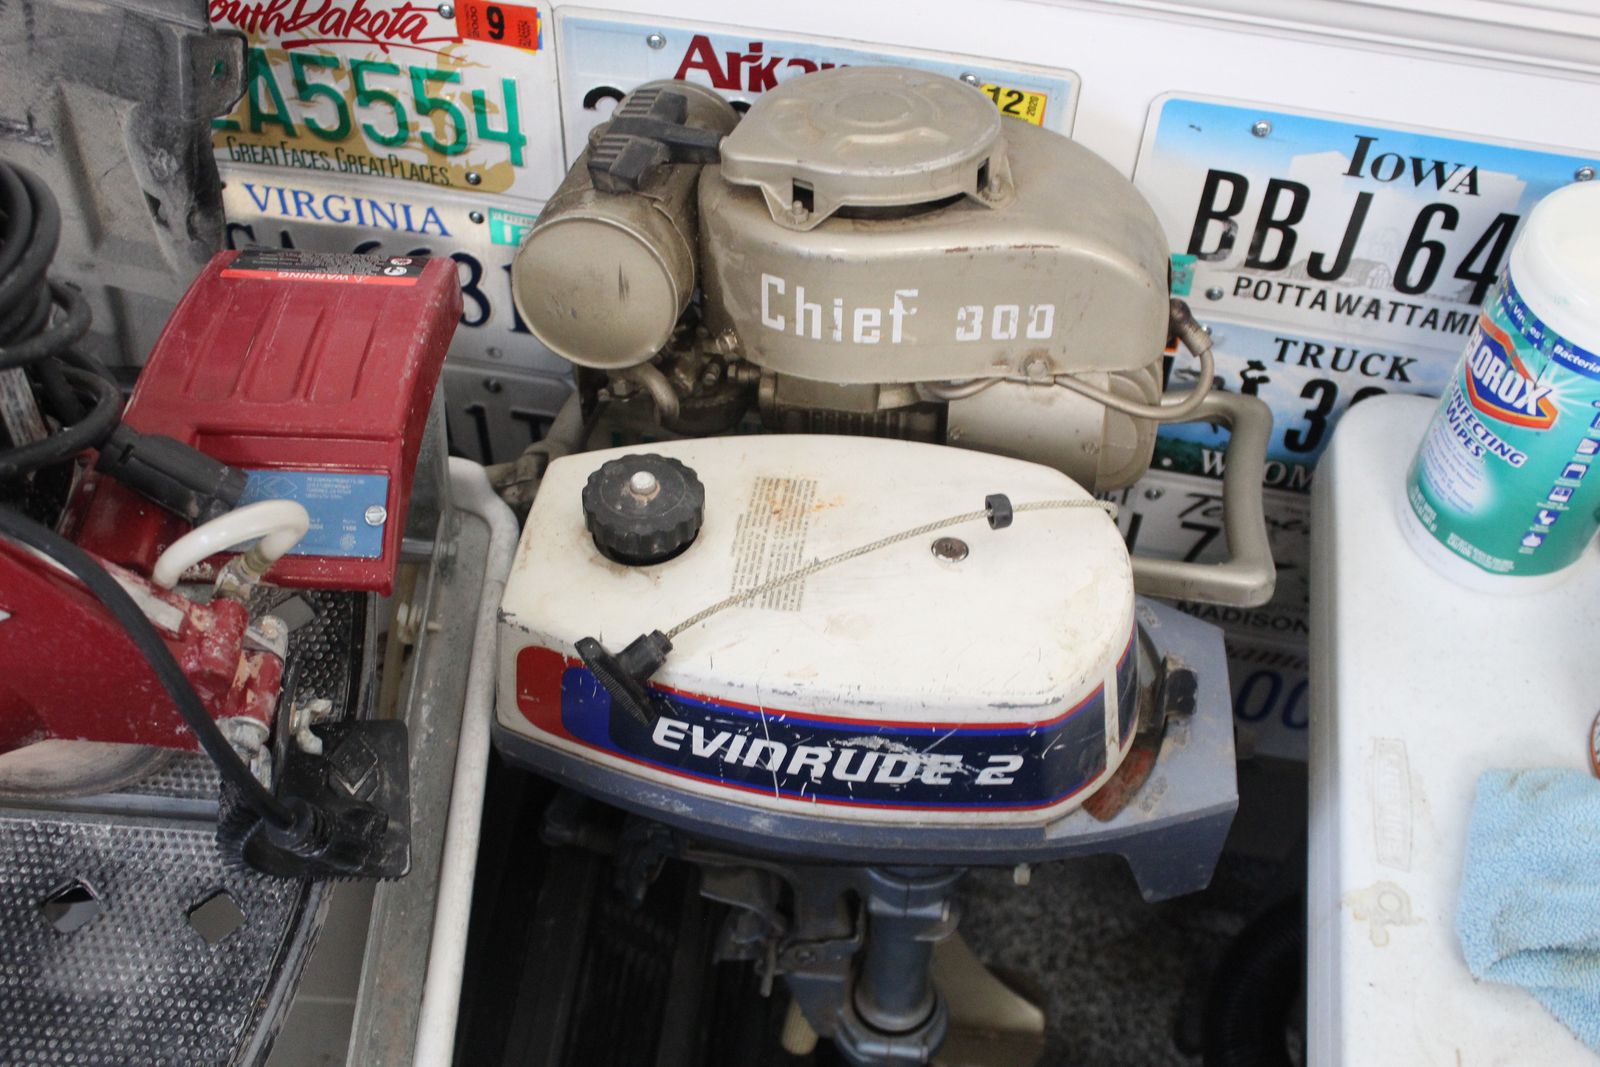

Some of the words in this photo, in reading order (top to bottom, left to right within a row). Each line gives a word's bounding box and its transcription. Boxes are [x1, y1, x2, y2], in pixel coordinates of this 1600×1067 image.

[209, 0, 288, 36] outh
[282, 0, 440, 50] Dakota
[486, 6, 505, 40] 9
[212, 47, 527, 167] A5554
[987, 86, 1025, 115] 12
[227, 136, 279, 164] GREAT
[335, 147, 386, 178] GREAT
[1342, 134, 1482, 196] IOWA
[245, 183, 452, 237] VIRGINIA
[1187, 168, 1374, 281] BBJ
[277, 272, 349, 281] WARNING
[761, 273, 918, 343] Chief
[956, 304, 1055, 341] 300
[1232, 275, 1479, 337] POTTAWATTAMI
[1273, 337, 1418, 383] TRUCK
[1446, 399, 1485, 458] WIPES
[975, 754, 1024, 785] 2
